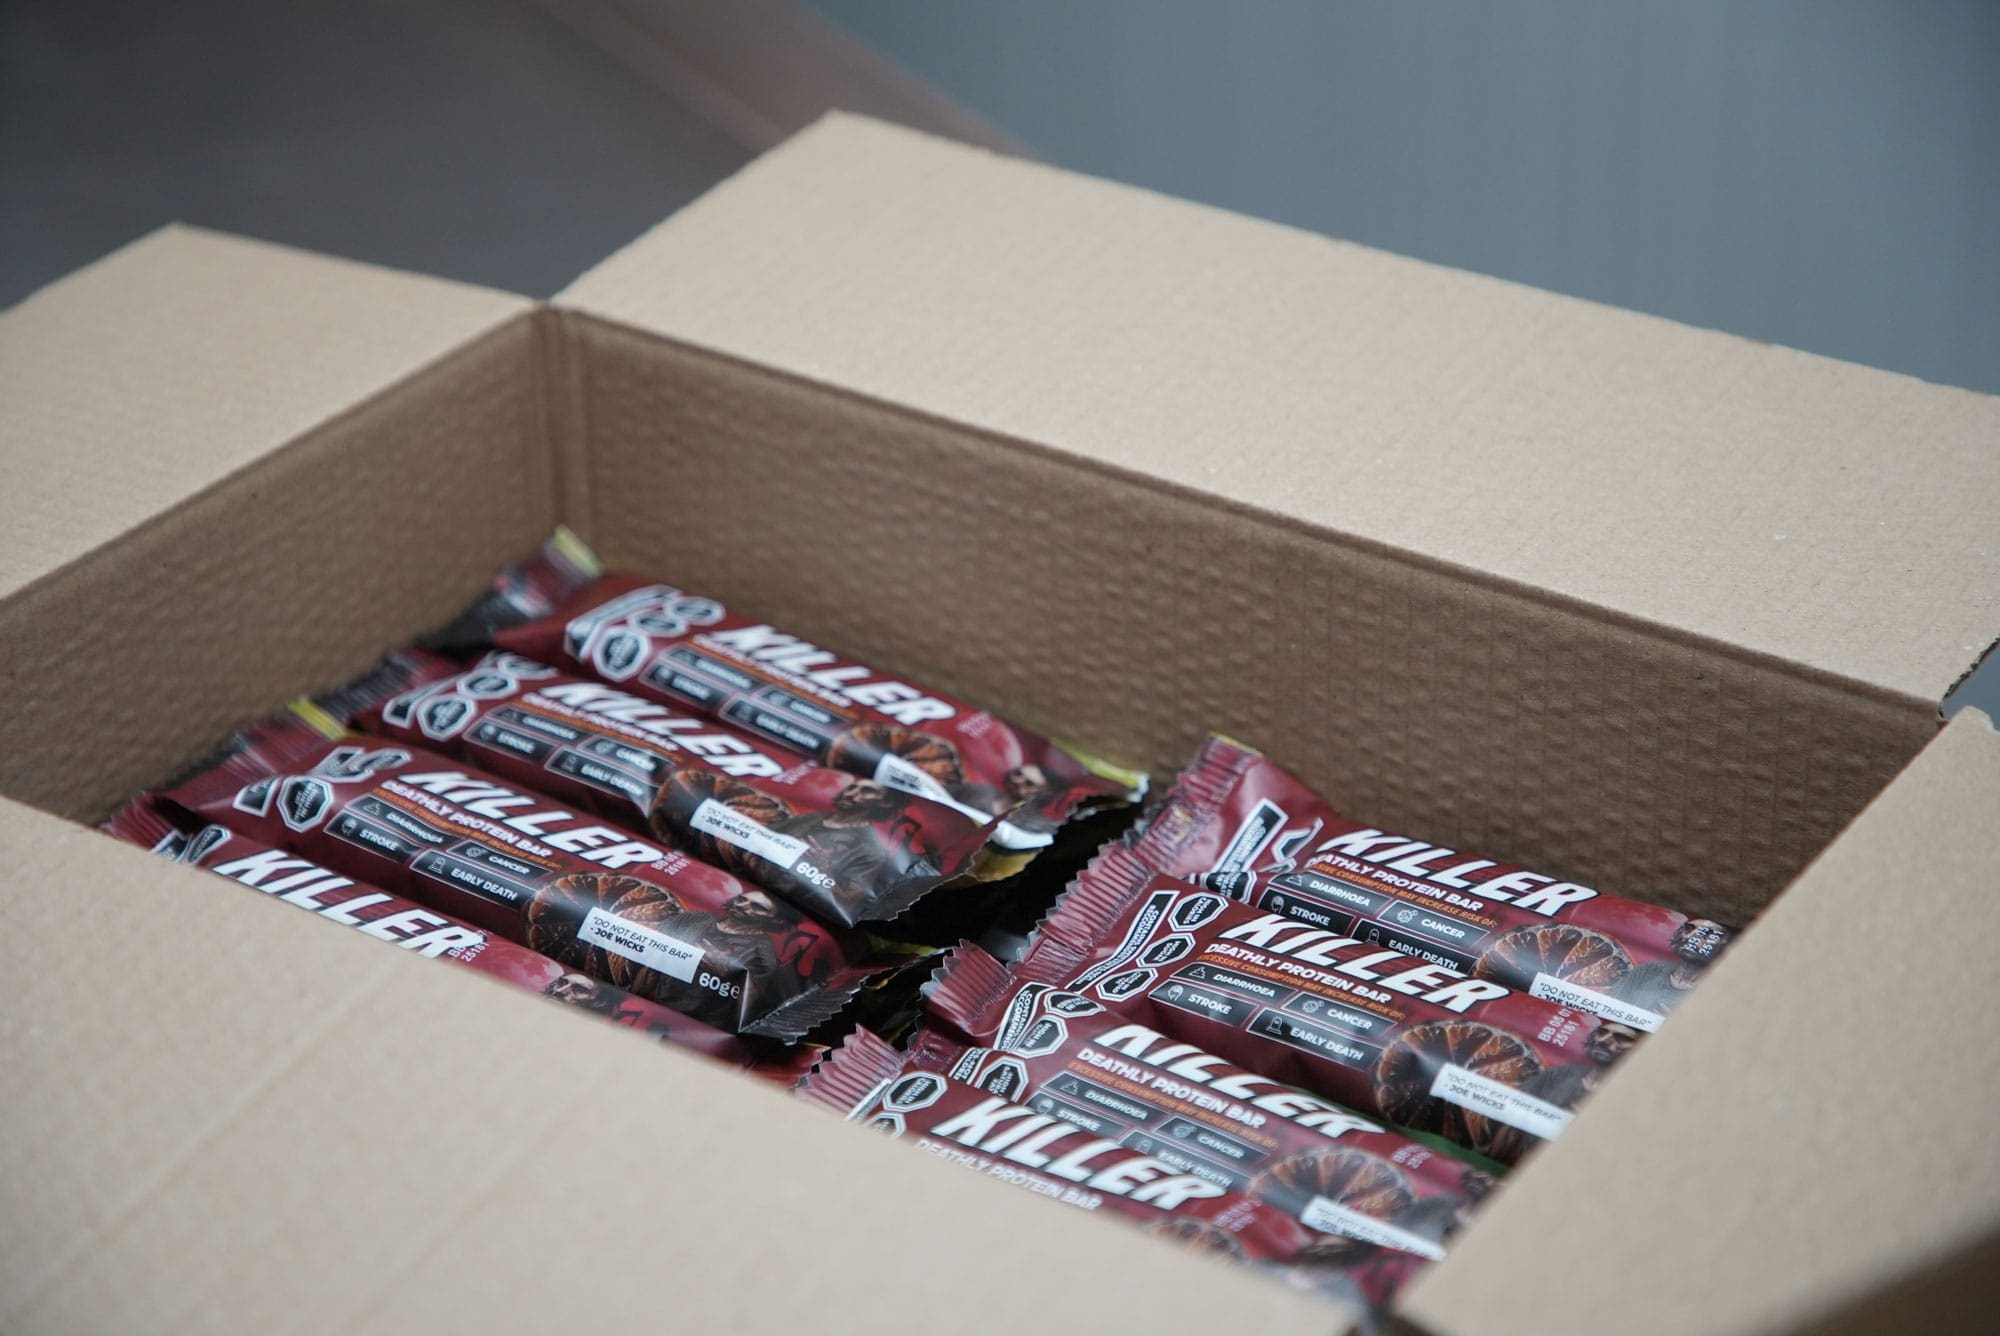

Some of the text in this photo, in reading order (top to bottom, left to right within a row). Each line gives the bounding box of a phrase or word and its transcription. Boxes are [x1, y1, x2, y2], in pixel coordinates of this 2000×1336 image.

[709, 624, 957, 726] KILLER
[539, 682, 784, 777] KILLER
[381, 779, 454, 817] DEATHLY
[449, 811, 521, 845] PROTEIN
[514, 836, 553, 858] BAR
[398, 771, 664, 869] KILLER
[705, 815, 751, 841] JOE WICKS
[359, 828, 401, 851] STROKE
[488, 854, 531, 876] CANCER
[1315, 828, 1599, 917] KILLER
[450, 867, 519, 901] EARLY DEATH
[1309, 879, 1371, 908] DIARRHOEA
[1373, 867, 1447, 902] PROTEIN
[1447, 889, 1485, 913] BAR
[211, 848, 484, 960] KILLER
[1182, 896, 1206, 924] CALORIES
[1196, 898, 1211, 914] HIGH
[1289, 904, 1331, 927] STROKE
[1396, 889, 1417, 900] MAY
[1415, 895, 1460, 915] INCREASE
[1458, 910, 1481, 923] RISK
[594, 927, 613, 941] JOE
[614, 934, 646, 954] WICKS
[610, 923, 631, 938] NOT
[629, 931, 649, 945] EAT
[649, 938, 670, 953] THIS
[1420, 916, 1466, 940] CANCER
[1218, 913, 1510, 1013] KILLER
[1387, 938, 1459, 971] EARLY DEATH
[1203, 942, 1392, 1005] DEATHLY PROTEIN BAR
[1212, 972, 1276, 999] DIARRHOEA
[1302, 981, 1324, 992] MAY
[1188, 992, 1232, 1016] STROKE
[1326, 1007, 1373, 1031] CANCER
[1559, 989, 1581, 1002] NOT
[1580, 997, 1602, 1011] EAT
[1601, 1004, 1624, 1019] THIS
[1034, 1022, 1051, 1038] HIGH
[1289, 1026, 1364, 1062] EARLY DEATH
[1537, 1026, 1556, 1042] BB
[1552, 1020, 1579, 1048] 25181
[1076, 1047, 1267, 1129] DEATHLY PROTEIN BAR
[1093, 1024, 1386, 1138] KILLER
[1084, 1090, 1149, 1121] DIARRHOEA
[1449, 1082, 1507, 1113] JOE WICKS
[1056, 1107, 1101, 1132] STROKE
[930, 1096, 1226, 1210] KILLER
[1198, 1134, 1246, 1160] CANCER
[916, 1139, 1104, 1212] DEATHLY PROTEIN BAR
[1158, 1151, 1234, 1188] EARLY DEATH
